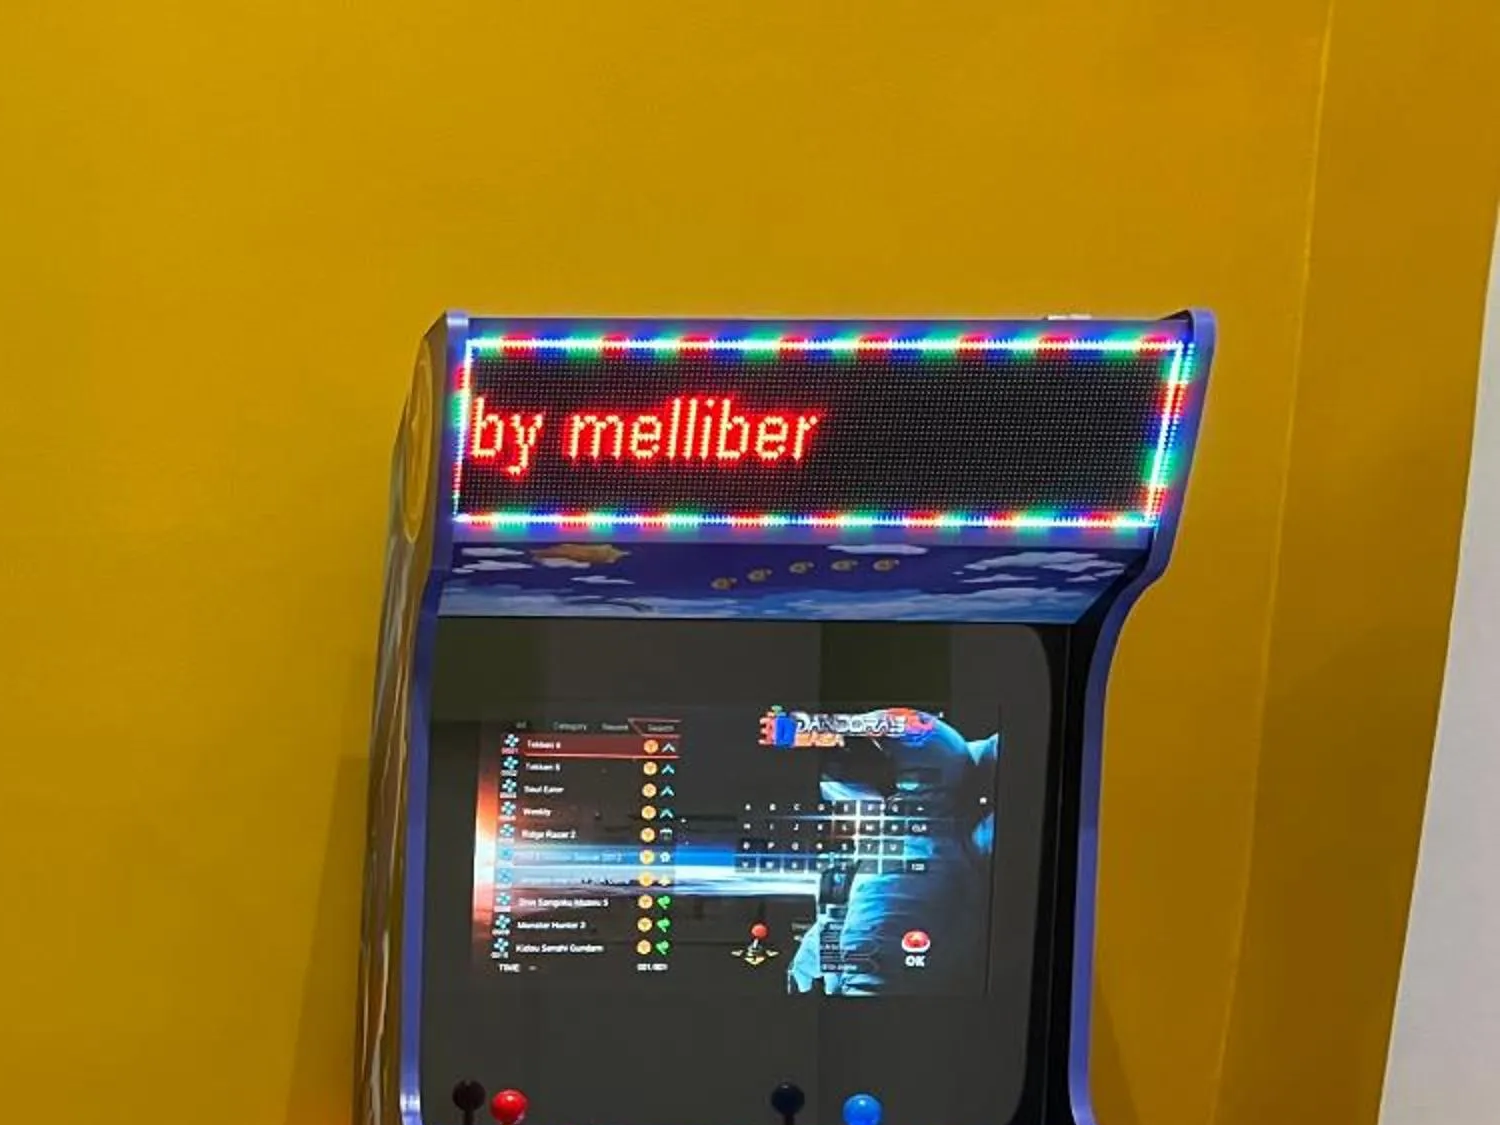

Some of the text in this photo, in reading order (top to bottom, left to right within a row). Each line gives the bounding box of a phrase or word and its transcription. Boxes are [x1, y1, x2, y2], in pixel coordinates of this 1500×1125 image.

[468, 396, 819, 475] by melliber
[904, 955, 926, 968] OK
